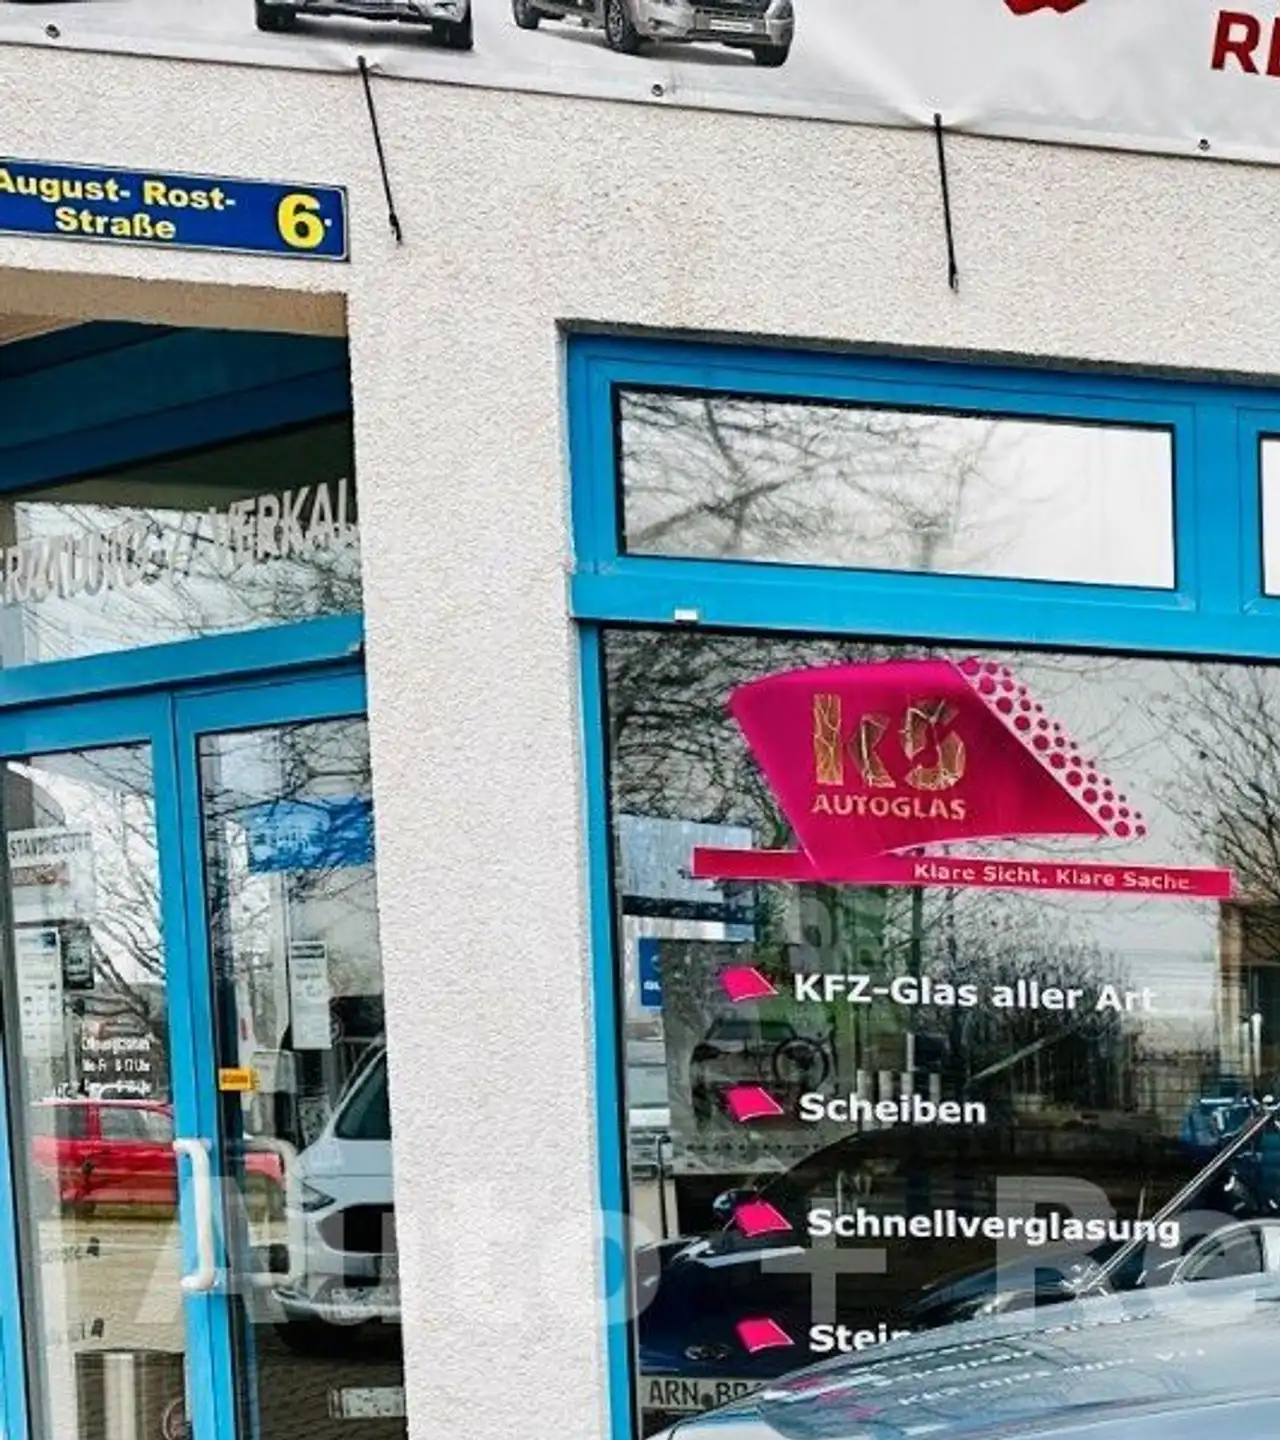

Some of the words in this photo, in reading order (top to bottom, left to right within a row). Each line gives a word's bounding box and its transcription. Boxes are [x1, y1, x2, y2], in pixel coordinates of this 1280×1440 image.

[0, 168, 131, 203] August-
[143, 180, 237, 212] Rost-
[55, 206, 177, 240] Straße
[277, 193, 325, 249] 6
[812, 793, 967, 821] AUTOGLAS
[914, 862, 976, 882] Klare
[983, 864, 1049, 886] Sicht.
[1055, 868, 1116, 888] Klare
[793, 973, 978, 1008] KFZ-Glas
[990, 979, 1084, 1011] aller
[1095, 985, 1157, 1013] Art
[799, 1093, 988, 1125] Scheiben
[807, 1208, 1181, 1249] Schnellverglasung
[650, 1379, 699, 1406] ARN
